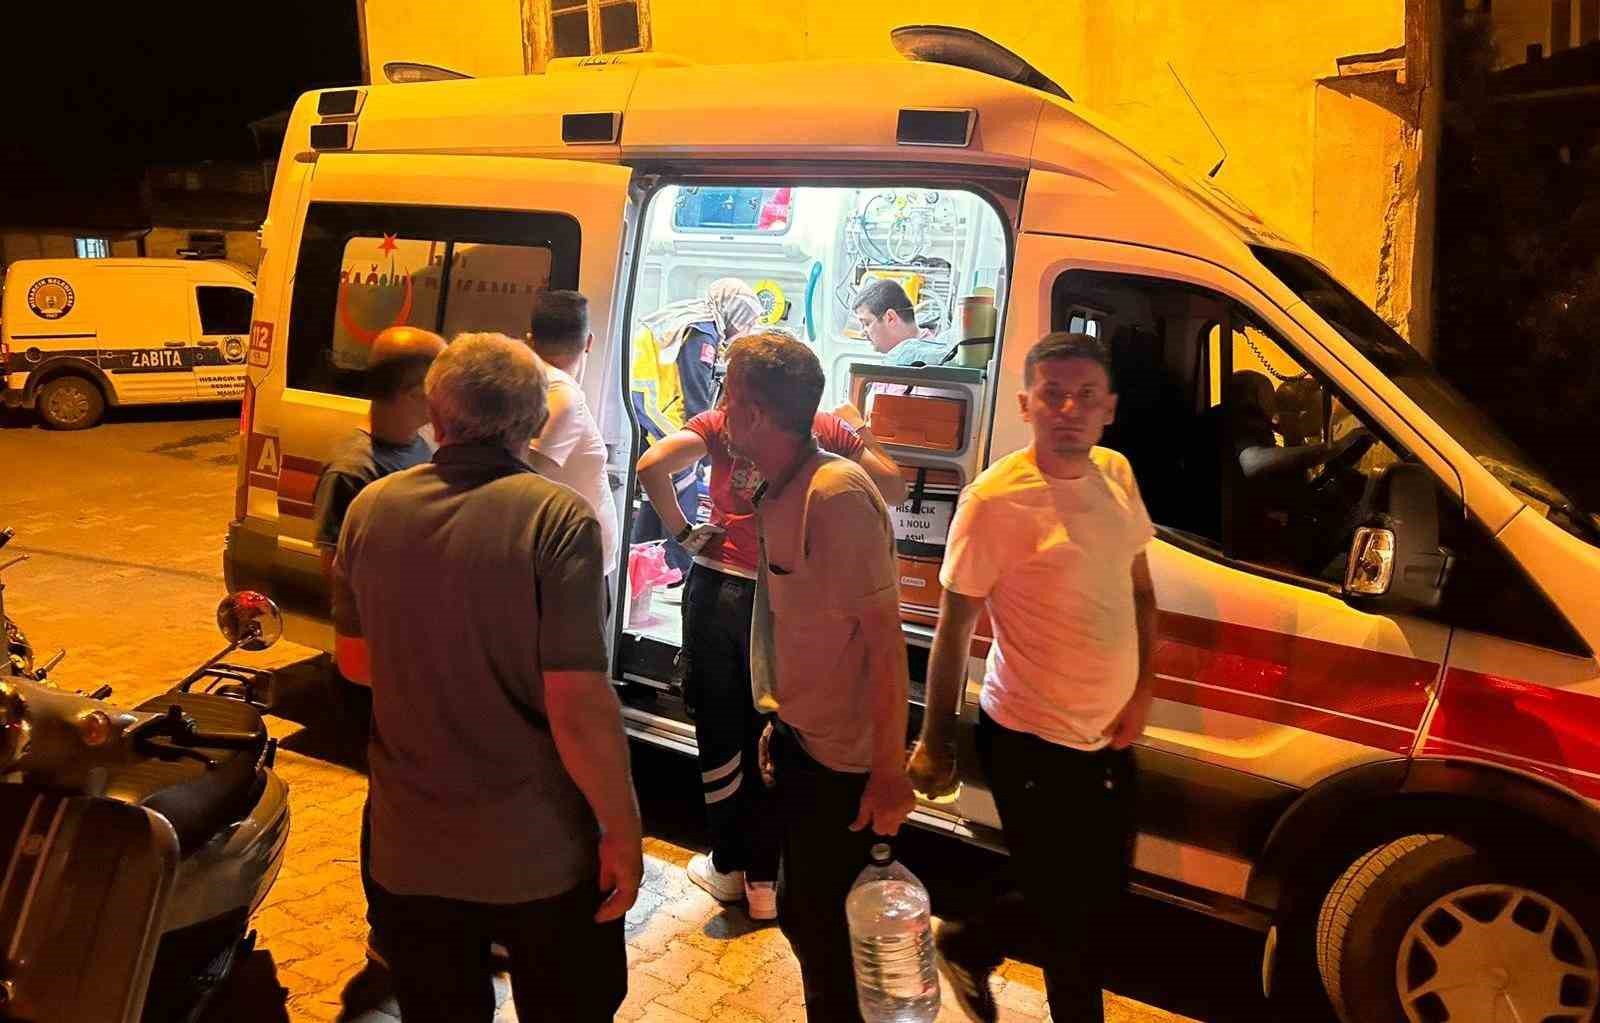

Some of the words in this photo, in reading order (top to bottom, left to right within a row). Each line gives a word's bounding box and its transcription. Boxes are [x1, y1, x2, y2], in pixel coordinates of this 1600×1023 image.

[131, 350, 183, 367] ZABITA
[257, 437, 278, 473] A
[900, 519, 904, 527] 1
[906, 519, 930, 529] NOLU
